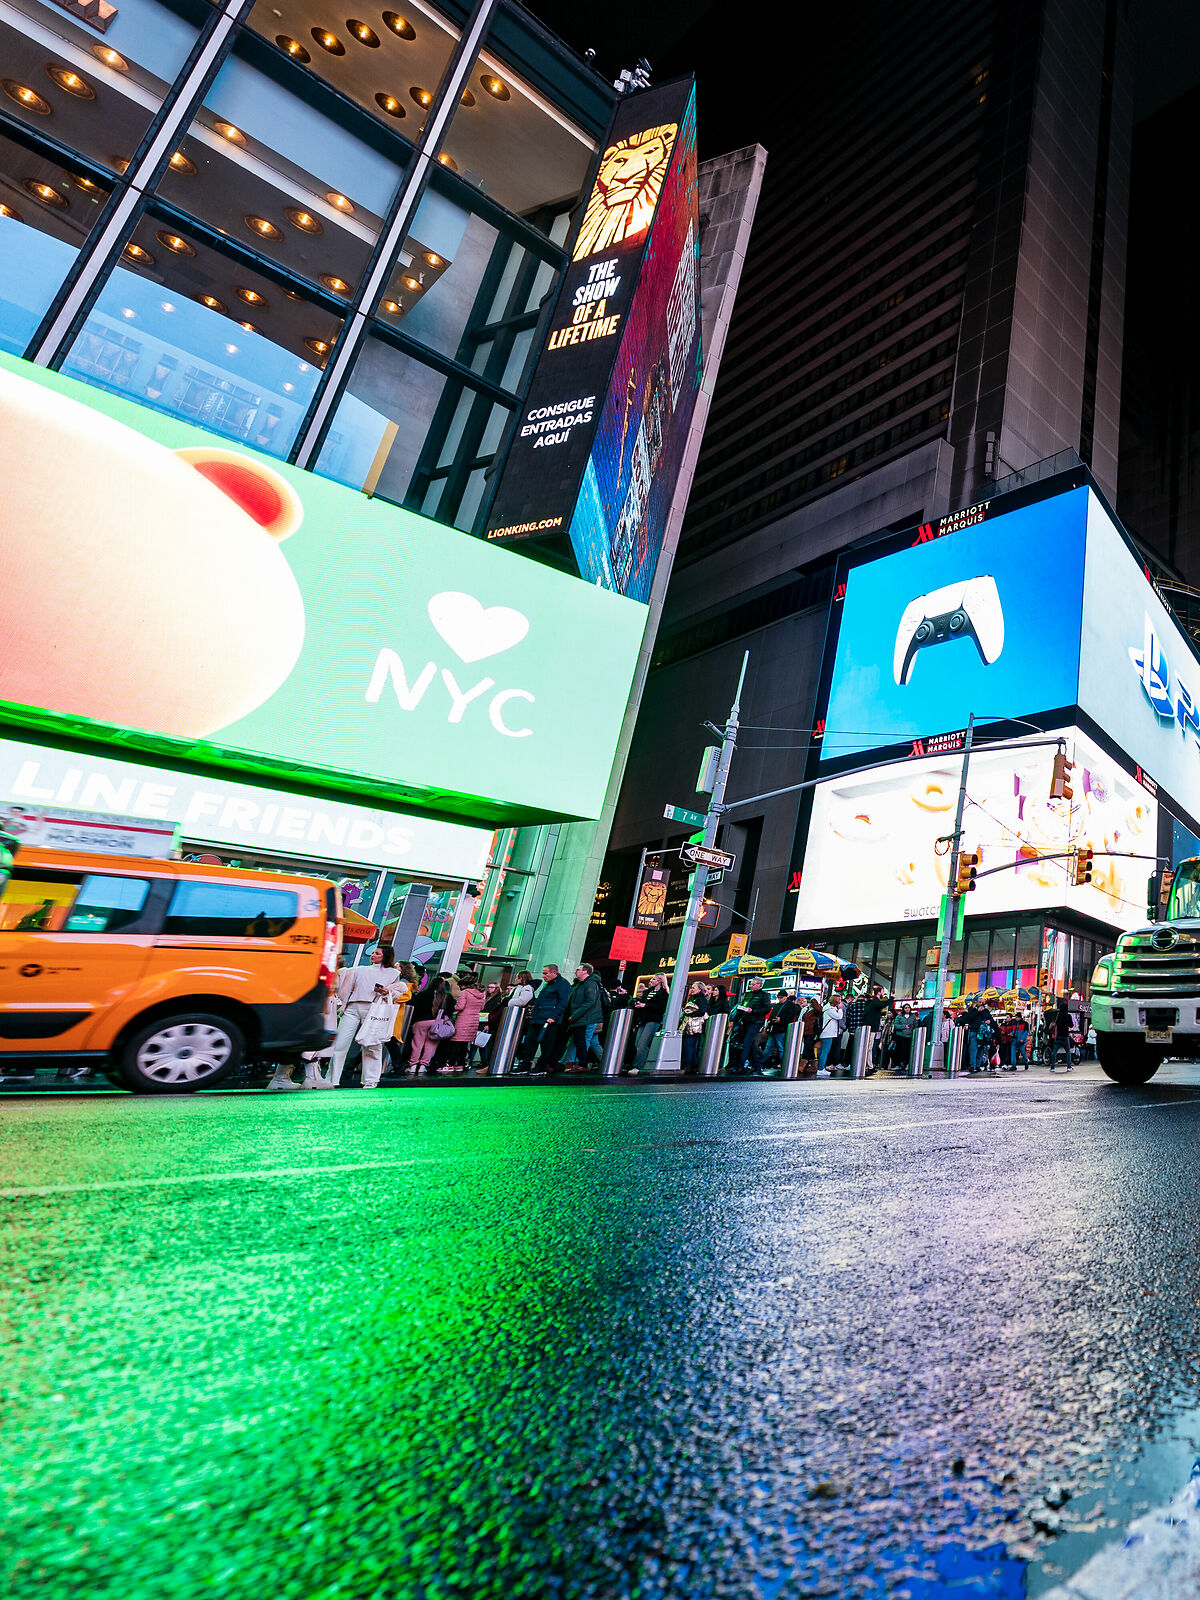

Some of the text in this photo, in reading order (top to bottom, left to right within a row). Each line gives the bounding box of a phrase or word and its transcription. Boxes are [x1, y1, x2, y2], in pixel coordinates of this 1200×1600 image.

[588, 258, 619, 284] THE
[573, 276, 621, 306] SHOW
[573, 299, 607, 325] OF A
[548, 314, 621, 351] LIFETIME
[527, 396, 596, 421] CONSIGUE
[520, 411, 593, 437] ENTRADAS
[533, 428, 572, 449] AQUÍ
[939, 513, 984, 537] MARQUIS
[940, 501, 991, 527] MARRIOTT
[487, 517, 563, 539] LIONKING.COM
[365, 648, 536, 737] NYC
[927, 740, 961, 753] MARQUIS
[928, 731, 966, 745] MARRIOTT
[10, 760, 415, 856] LINE FRIENDS
[682, 811, 688, 821] 7
[689, 849, 728, 866] ONE WAY
[784, 961, 815, 969] SABRETT
